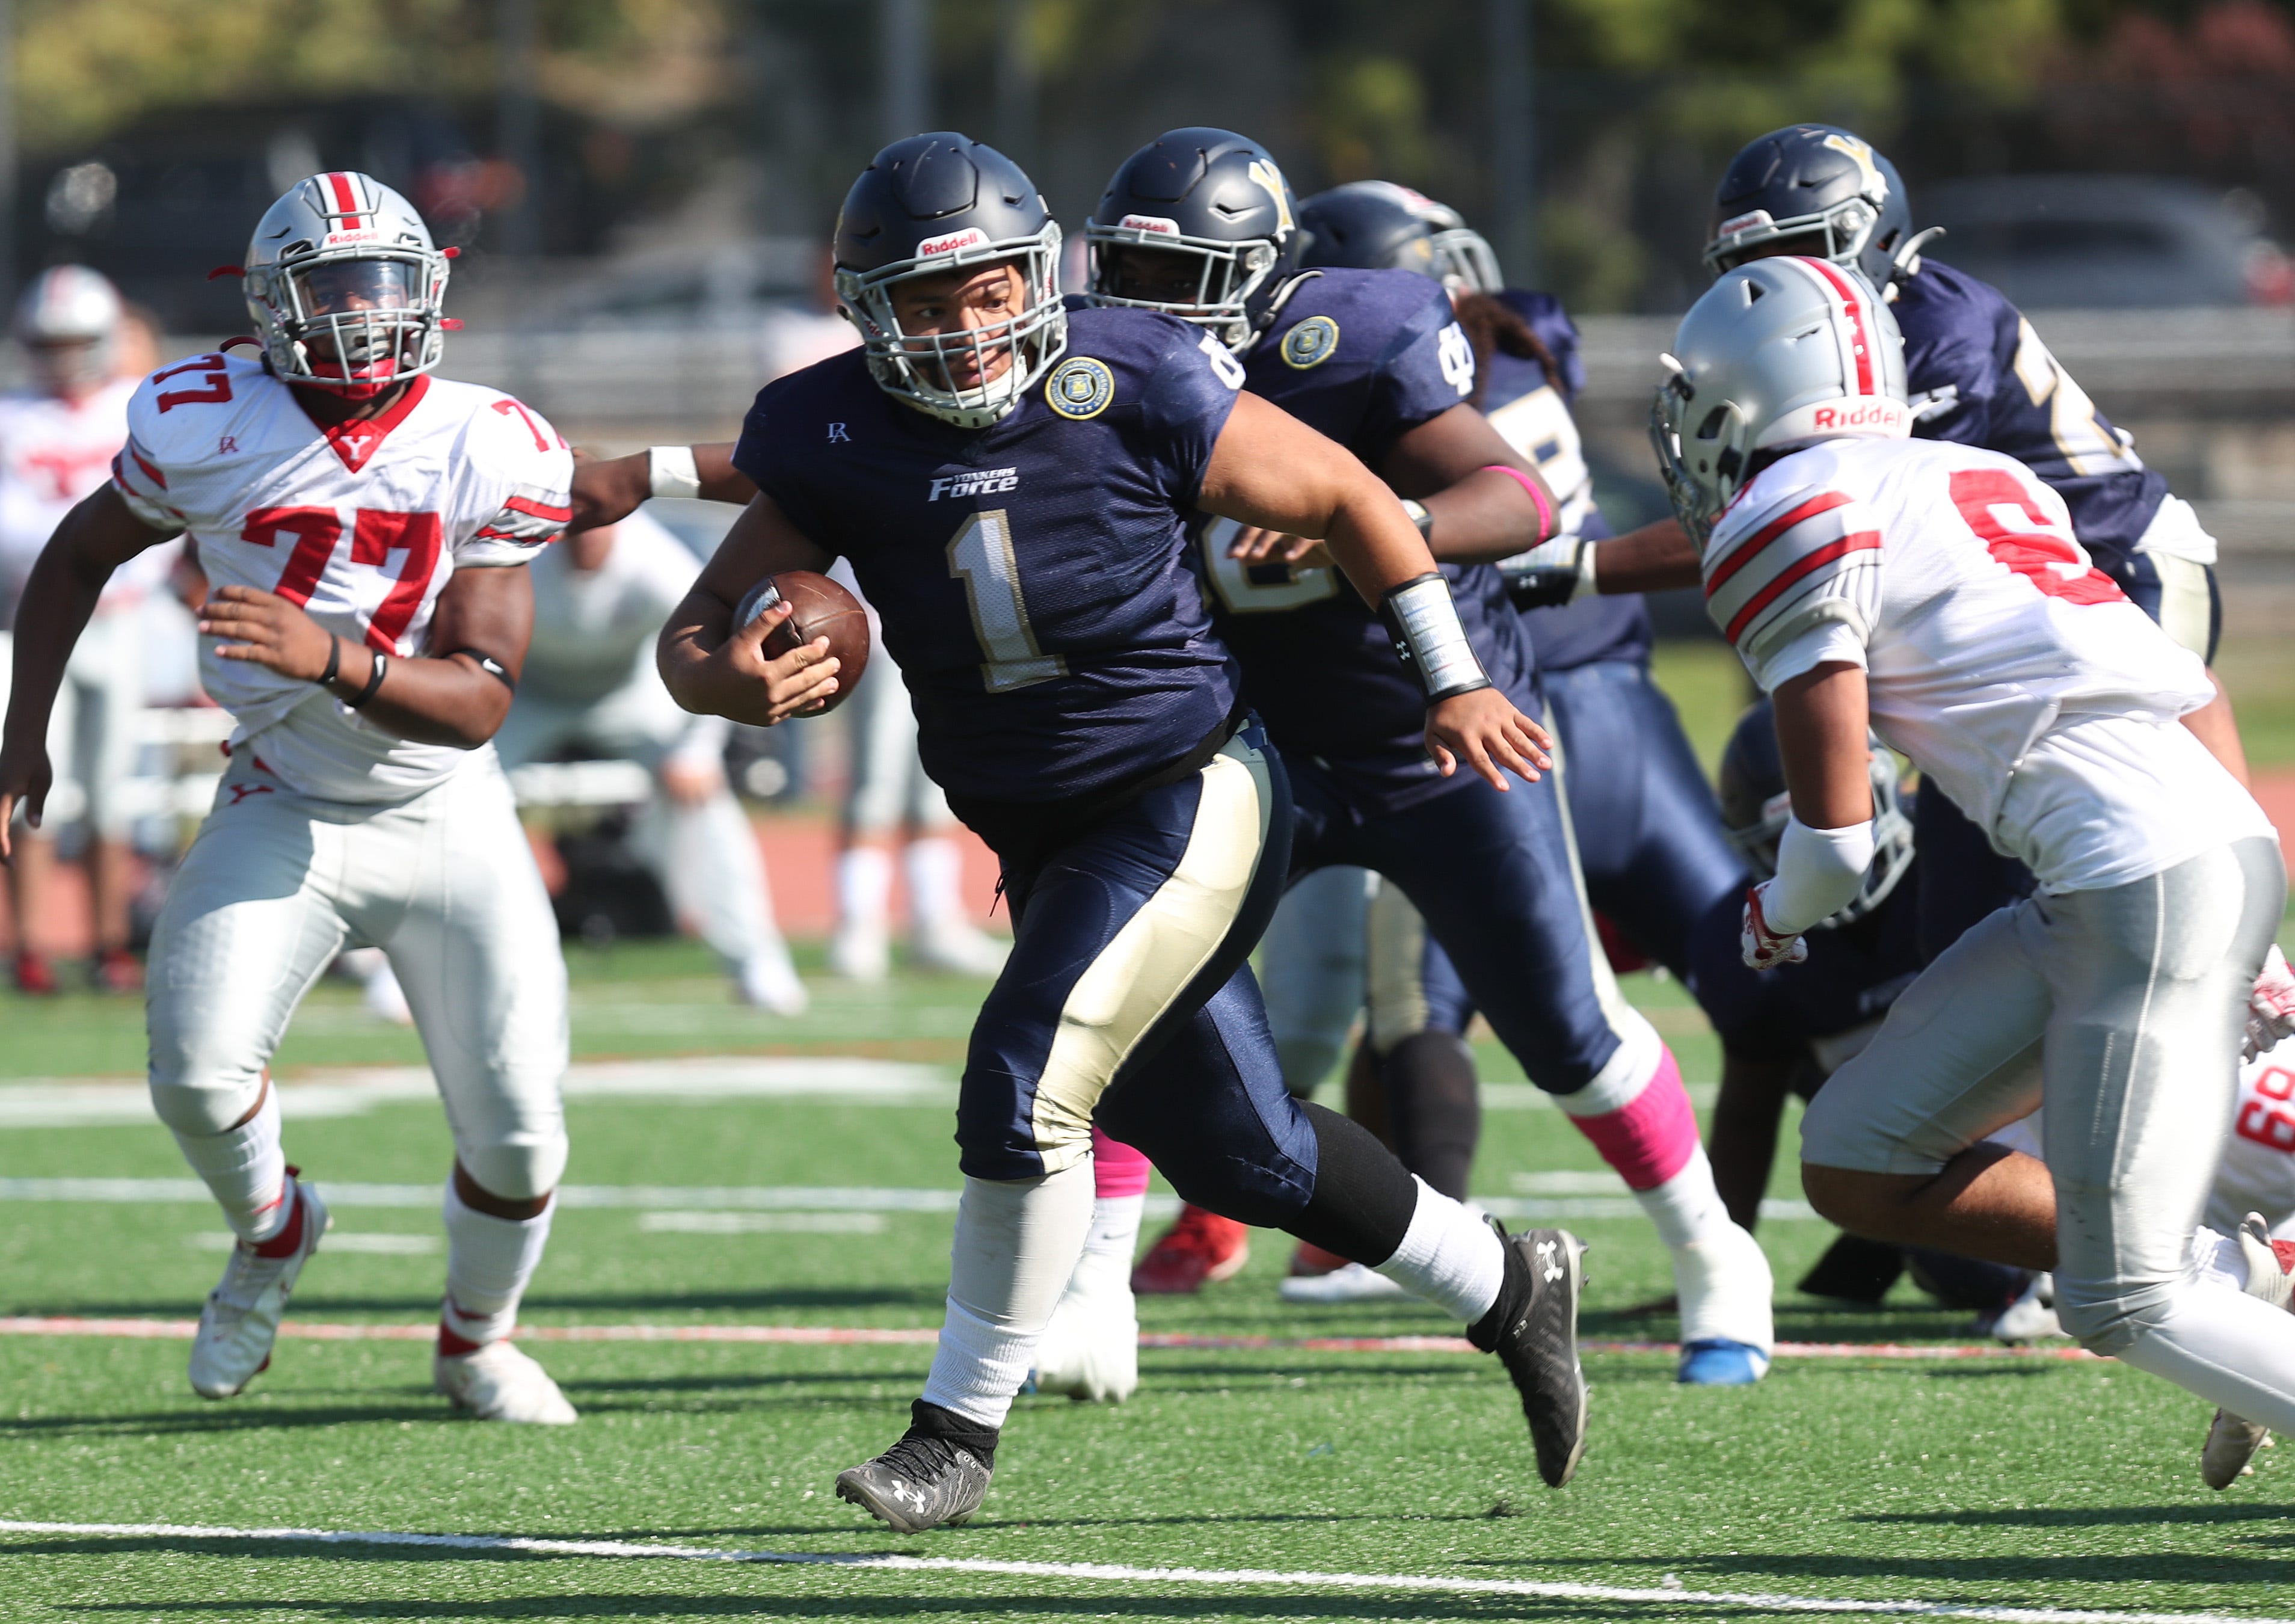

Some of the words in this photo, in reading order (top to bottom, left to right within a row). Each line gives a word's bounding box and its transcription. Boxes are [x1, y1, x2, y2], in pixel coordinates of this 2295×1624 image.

[922, 232, 978, 256] Riddell
[339, 435, 372, 460] Y
[954, 467, 1017, 482] YONKERS
[927, 476, 1019, 502] Force
[241, 506, 442, 658] 77
[945, 509, 1071, 694] 1
